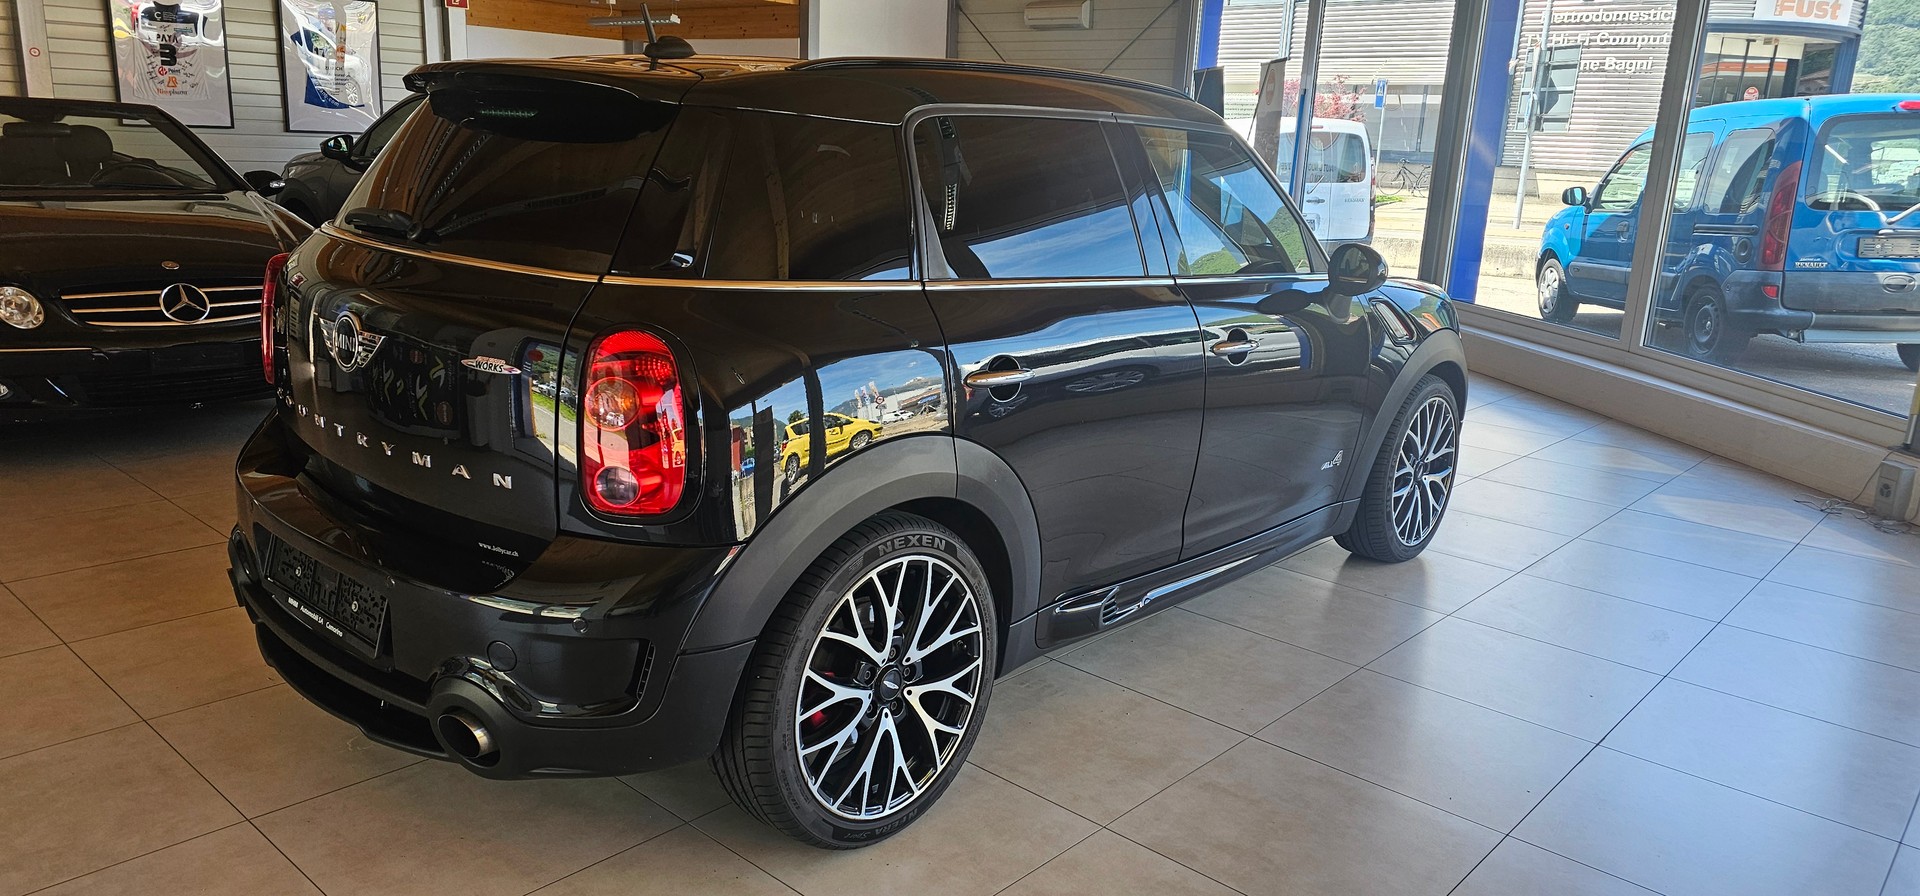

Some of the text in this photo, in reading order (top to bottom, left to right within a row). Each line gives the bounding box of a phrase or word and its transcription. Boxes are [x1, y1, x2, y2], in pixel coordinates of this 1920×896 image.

[159, 43, 177, 66] 3
[1605, 56, 1654, 73] Bagni
[337, 333, 356, 352] MINI
[475, 360, 504, 373] WORKS
[877, 534, 946, 557] NEXEN
